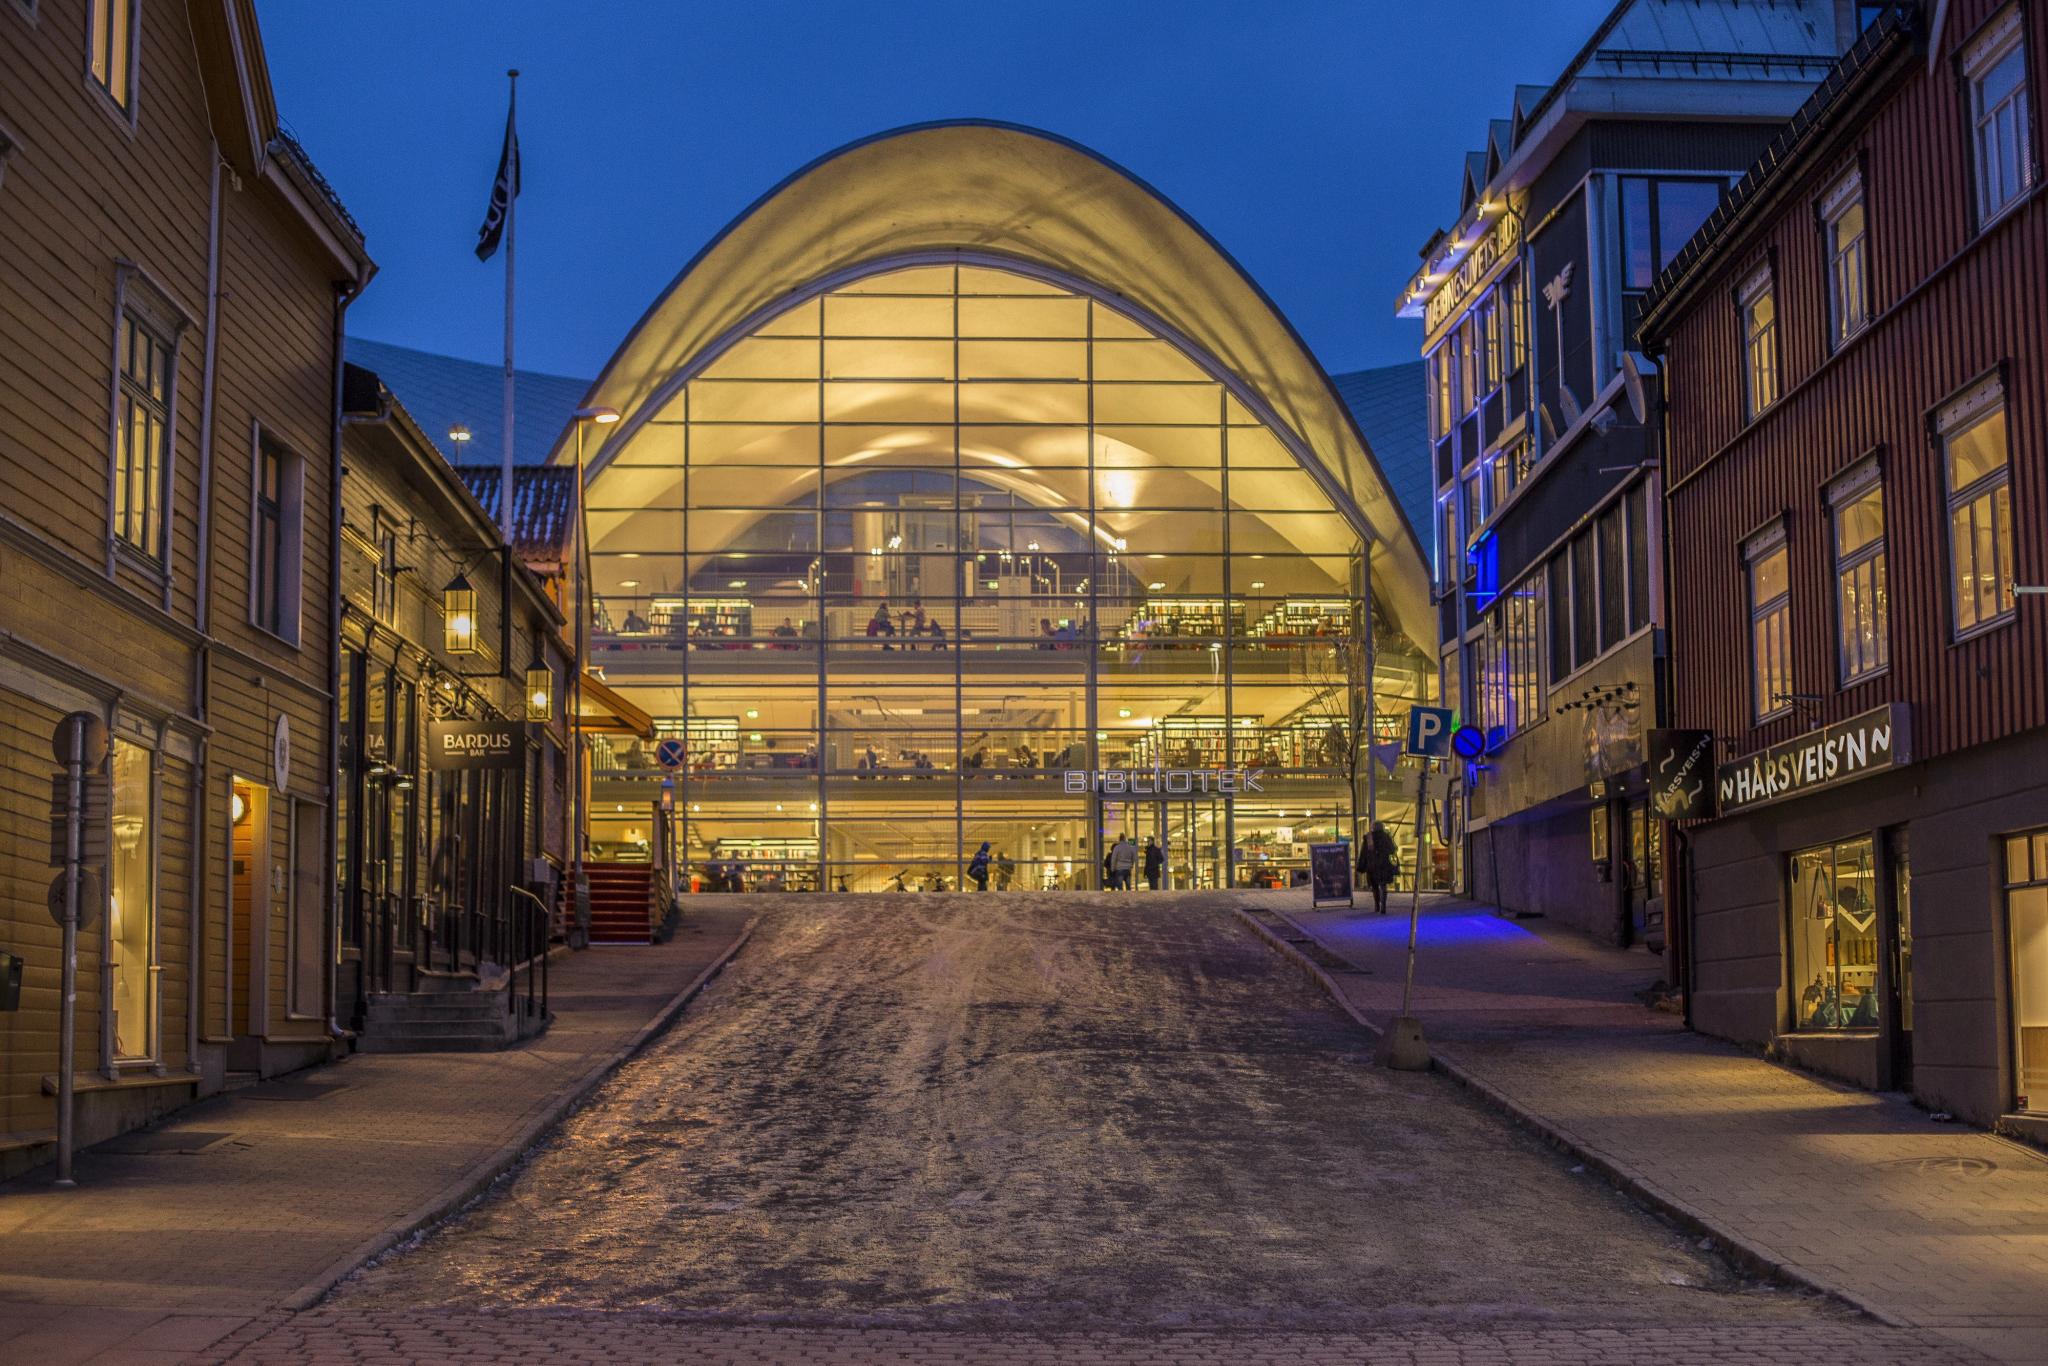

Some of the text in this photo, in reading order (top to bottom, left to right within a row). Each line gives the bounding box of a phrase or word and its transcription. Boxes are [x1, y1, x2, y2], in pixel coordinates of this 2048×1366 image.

[443, 733, 511, 749] BARDUS
[1418, 712, 1441, 750] P
[469, 749, 485, 757] BAR
[1064, 769, 1265, 794] BIBLIOTEK
